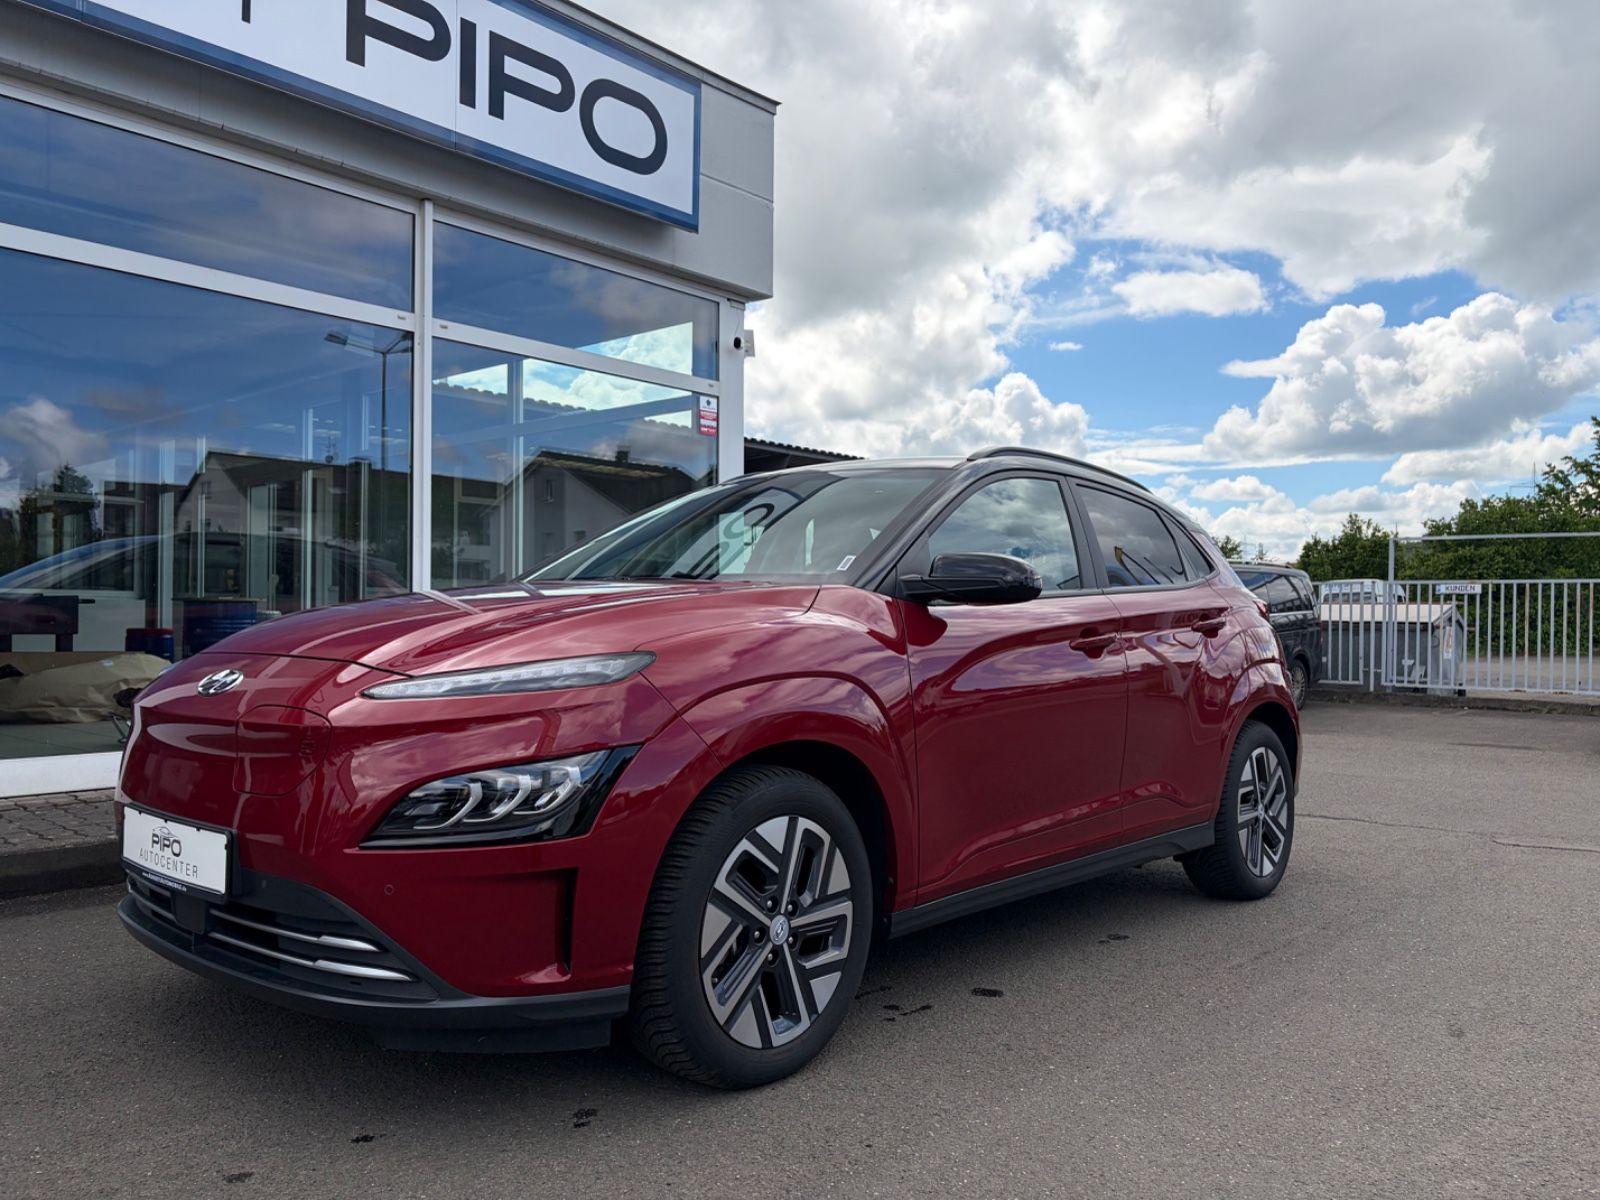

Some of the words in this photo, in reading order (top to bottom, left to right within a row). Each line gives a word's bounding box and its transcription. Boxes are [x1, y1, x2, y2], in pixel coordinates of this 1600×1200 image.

[346, 0, 668, 175] PIPO
[151, 833, 182, 857] PIPO
[139, 847, 198, 879] AUTOCENTER
